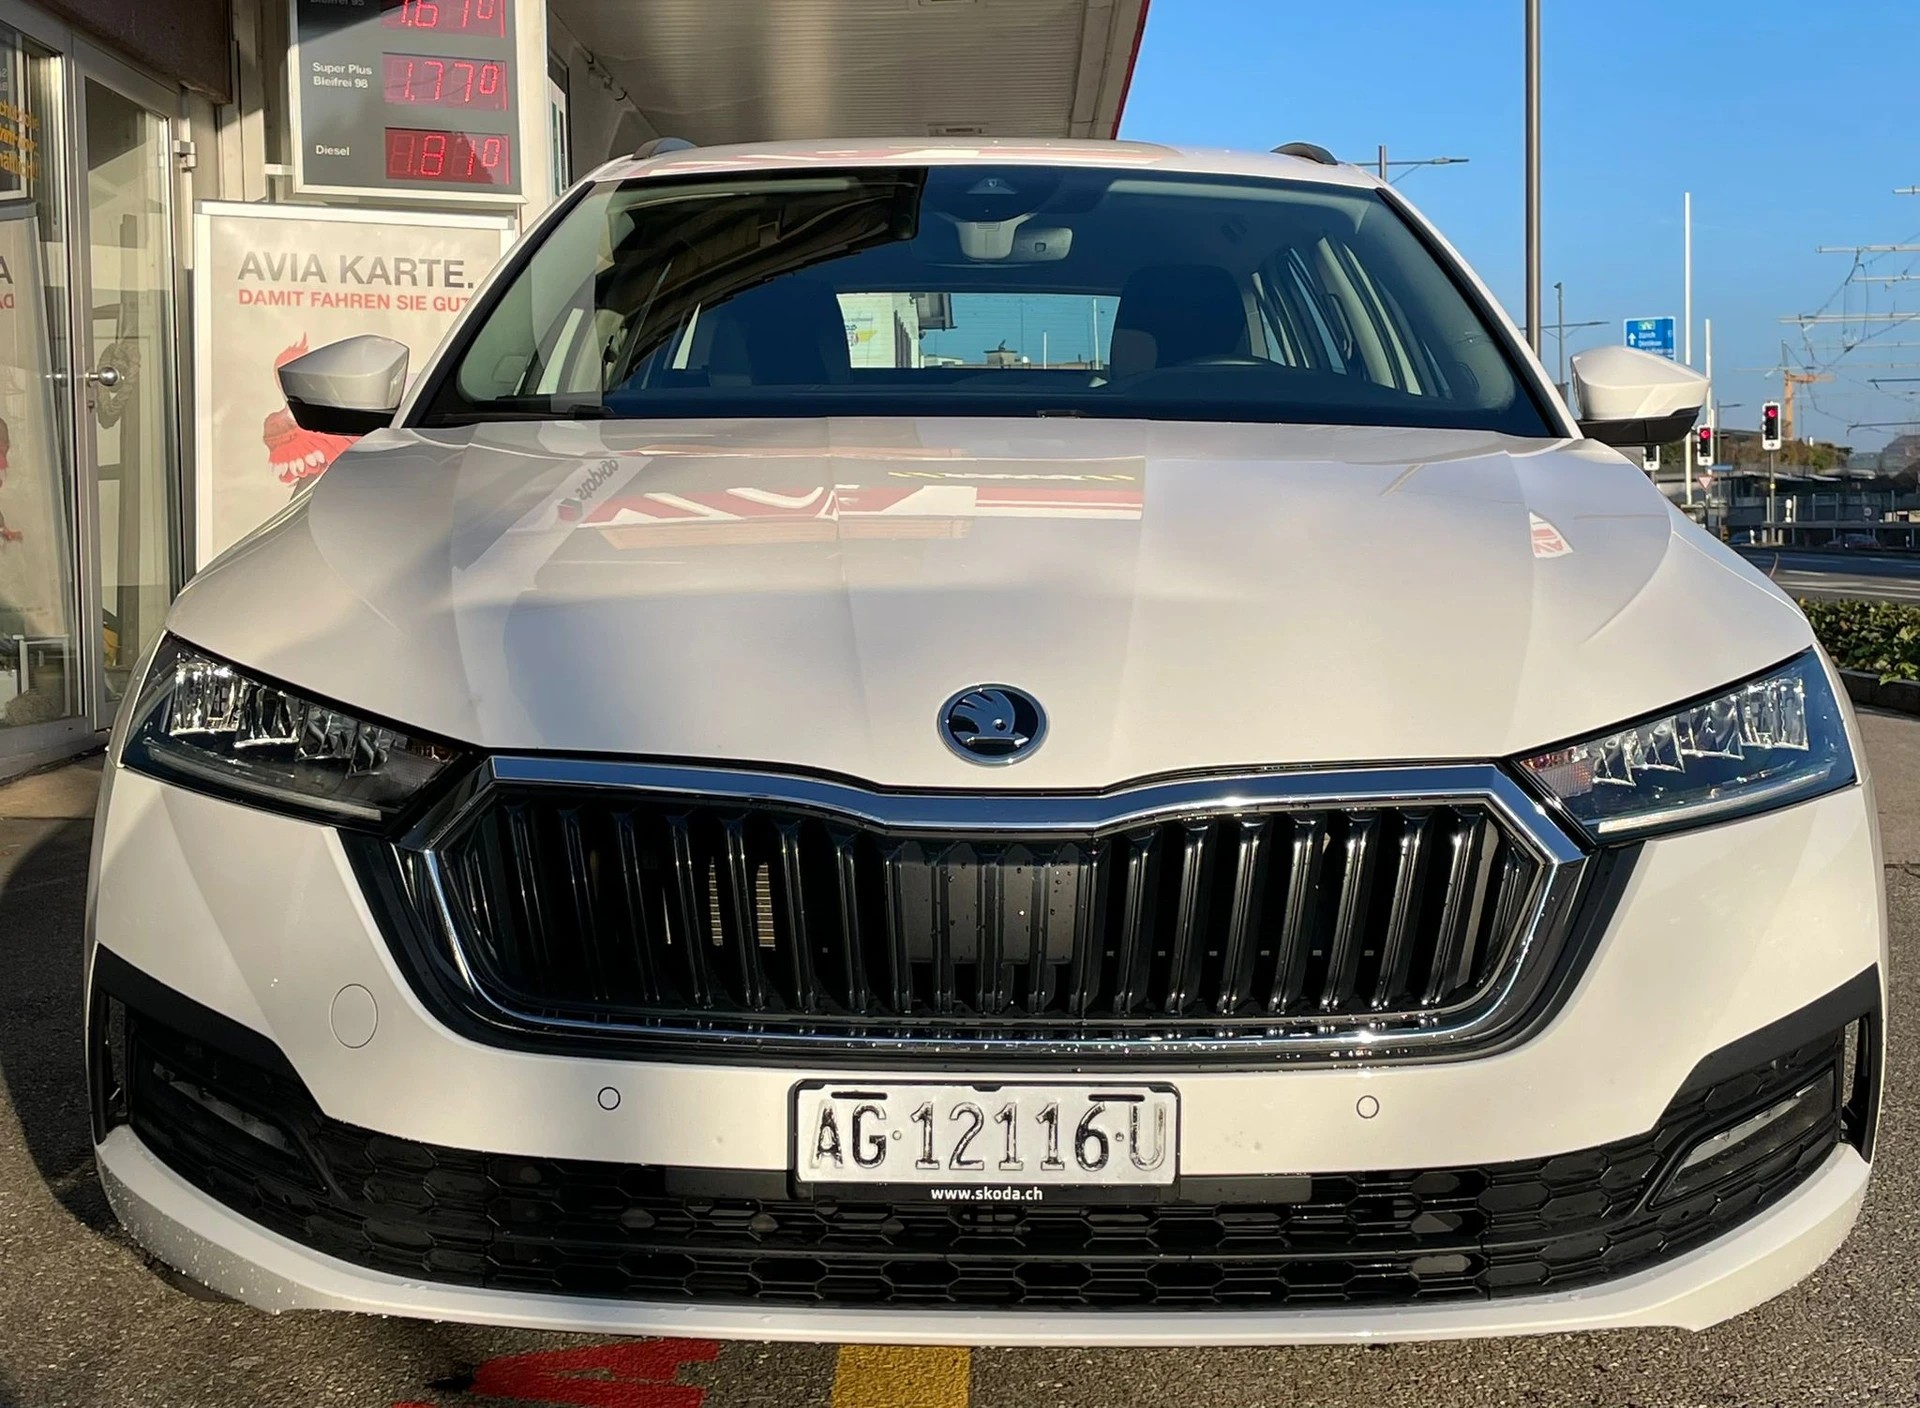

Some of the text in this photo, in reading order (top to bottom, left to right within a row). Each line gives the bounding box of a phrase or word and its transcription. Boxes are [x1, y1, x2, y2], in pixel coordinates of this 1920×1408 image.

[312, 62, 373, 75] Super Plus
[313, 75, 369, 89] Bleifrei 98
[315, 144, 351, 157] Diesel
[238, 251, 474, 289] AVIA KARTE.
[238, 289, 305, 306] DAMIT
[310, 292, 391, 310] FAHREN
[396, 295, 427, 311] SIE
[930, 1186, 1044, 1201] www.skoda.ch
